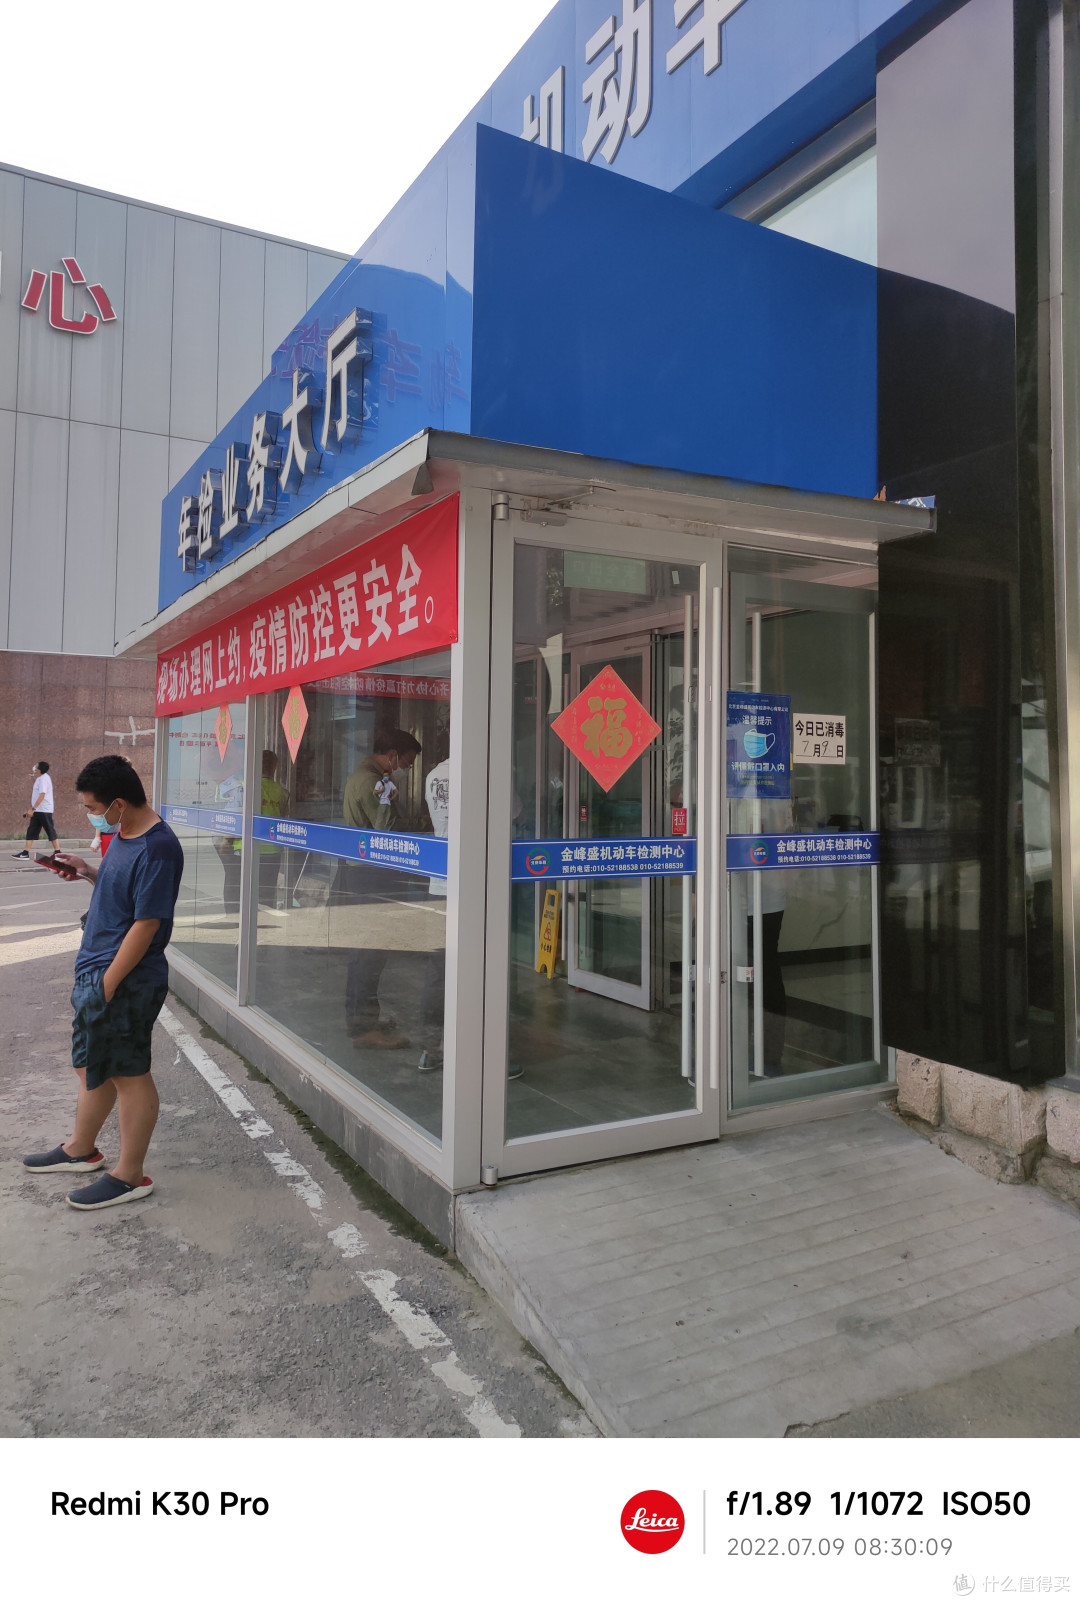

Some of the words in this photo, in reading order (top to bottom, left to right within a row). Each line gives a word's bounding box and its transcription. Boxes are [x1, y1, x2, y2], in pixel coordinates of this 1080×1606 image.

[21, 256, 117, 334] 心
[178, 307, 368, 572] 年检业务大厅
[580, 696, 633, 758] 福
[742, 715, 772, 726] 温馨提示
[795, 720, 844, 738] 今日已消毒
[673, 812, 686, 826] 拉
[370, 835, 420, 856] 金峰盛机动车检测中心
[560, 845, 685, 862] 金峰盛机动车检测中心
[776, 837, 872, 853] 金峰盛机动车检测中心
[639, 862, 684, 870] 010-52188539
